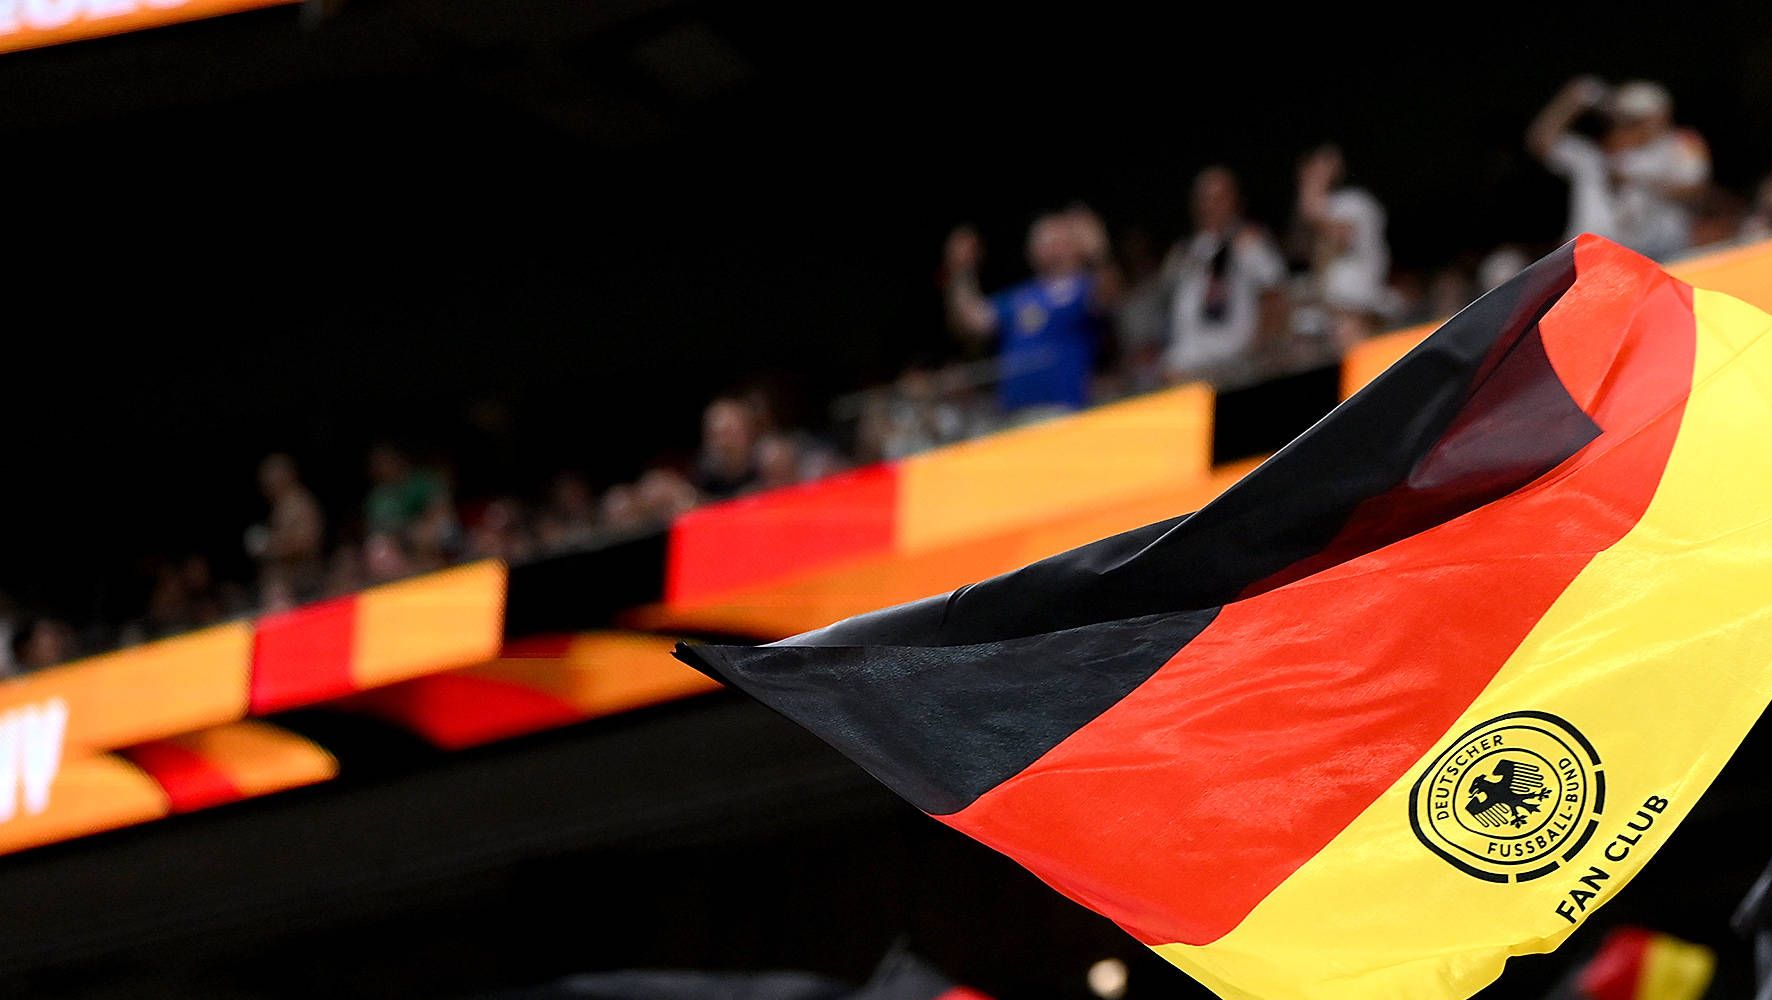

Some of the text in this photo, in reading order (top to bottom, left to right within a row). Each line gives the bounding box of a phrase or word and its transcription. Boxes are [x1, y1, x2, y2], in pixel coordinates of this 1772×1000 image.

[1436, 734, 1505, 821] DEUTSCHER
[1487, 757, 1580, 858] FUSSBALL-BUND
[1555, 793, 1670, 925] FAN CLUB
